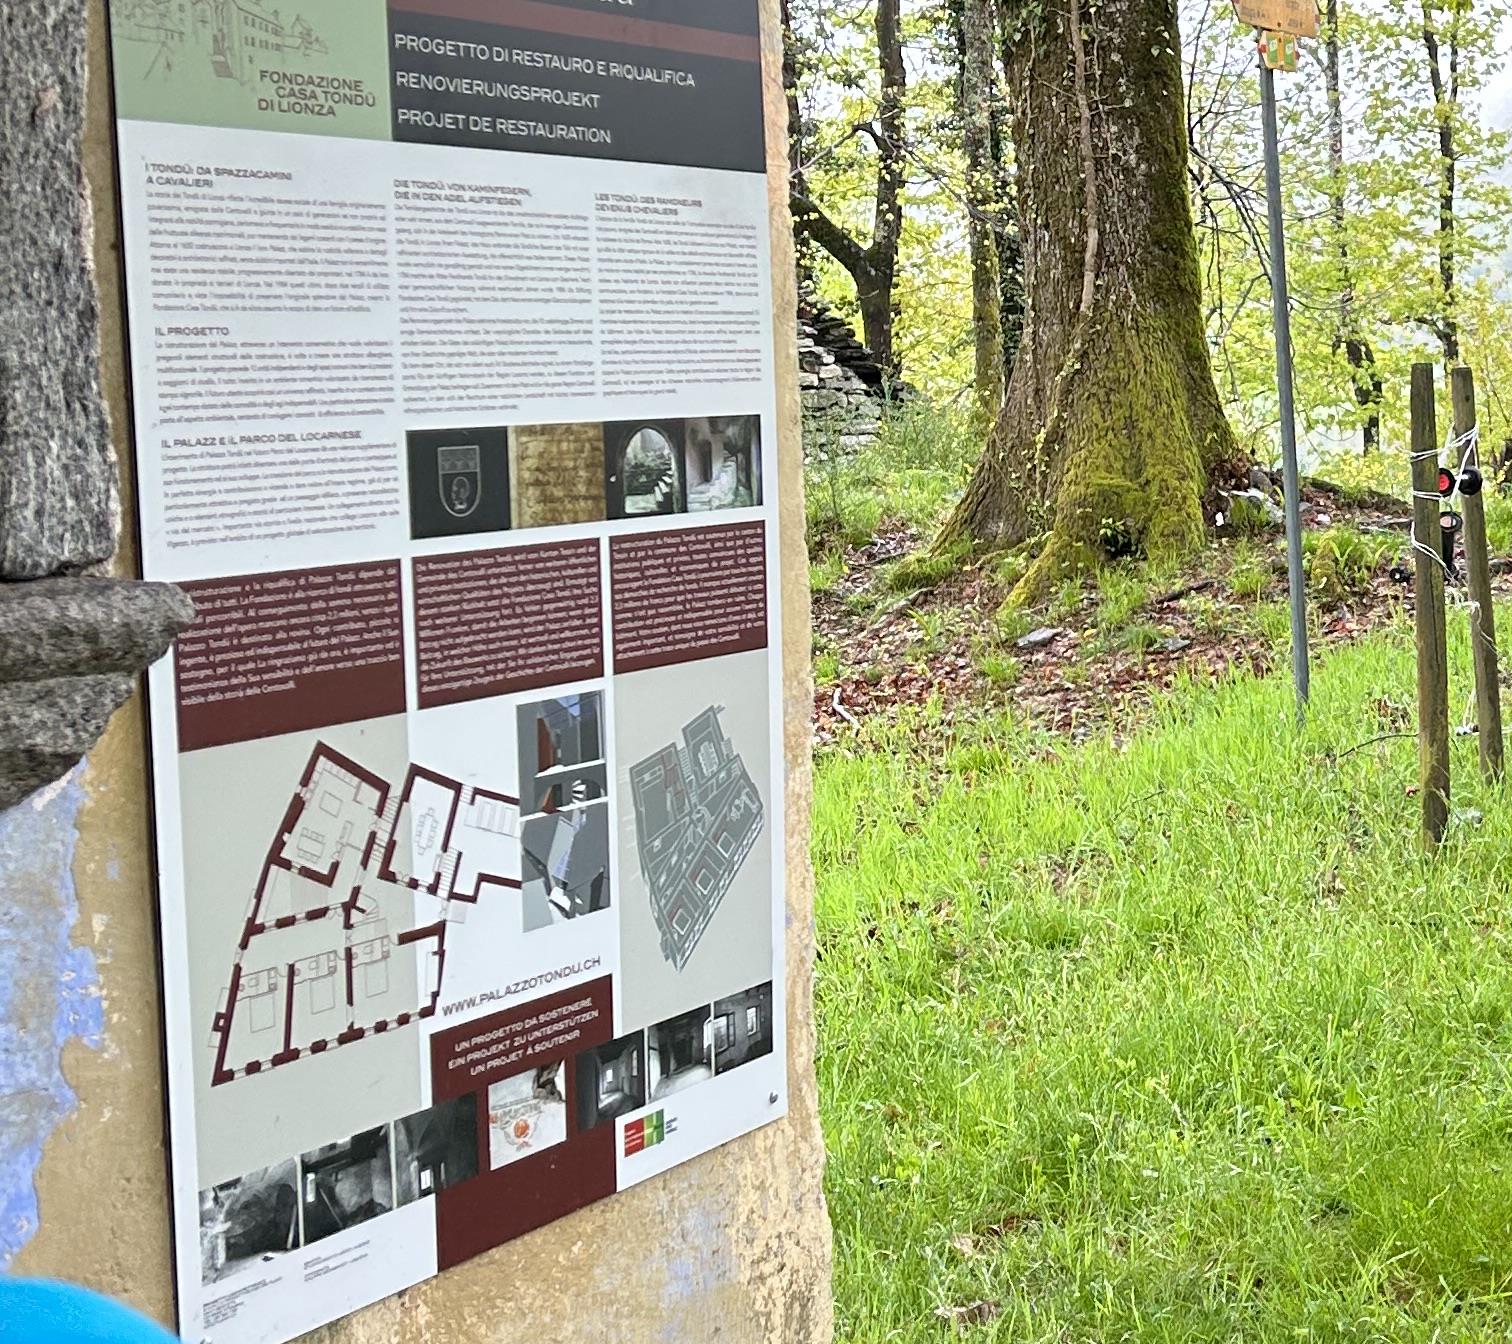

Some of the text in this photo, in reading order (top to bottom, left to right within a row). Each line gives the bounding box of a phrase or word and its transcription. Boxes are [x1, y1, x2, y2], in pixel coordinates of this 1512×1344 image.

[394, 33, 696, 87] PROGETTO DI RESTAURO E RIQUALIFICA
[259, 69, 364, 93] FONDAZIONE
[275, 86, 319, 102] CASA
[396, 71, 600, 109] RENOVIERUNGSPROJEKT
[257, 98, 336, 117] DI LIONZA
[397, 108, 611, 144] PROJET DE RESTAURATION
[145, 176, 154, 185] A
[196, 166, 212, 176] DA
[154, 326, 230, 337] IL PROGETTO
[160, 439, 171, 449] IL
[239, 433, 276, 445] PARCO
[300, 430, 362, 442] LOCARNESE
[442, 955, 601, 1017] WWW.PALAZZOTONDU.CH
[454, 997, 593, 1052] UN PROGETTO DA SOSTENERE
[466, 1040, 511, 1065] PROJEKT
[513, 1035, 527, 1047] ZU
[470, 1062, 486, 1076] UN
[486, 1050, 524, 1070] PROJET
[534, 1029, 581, 1054] SOUTENIR
